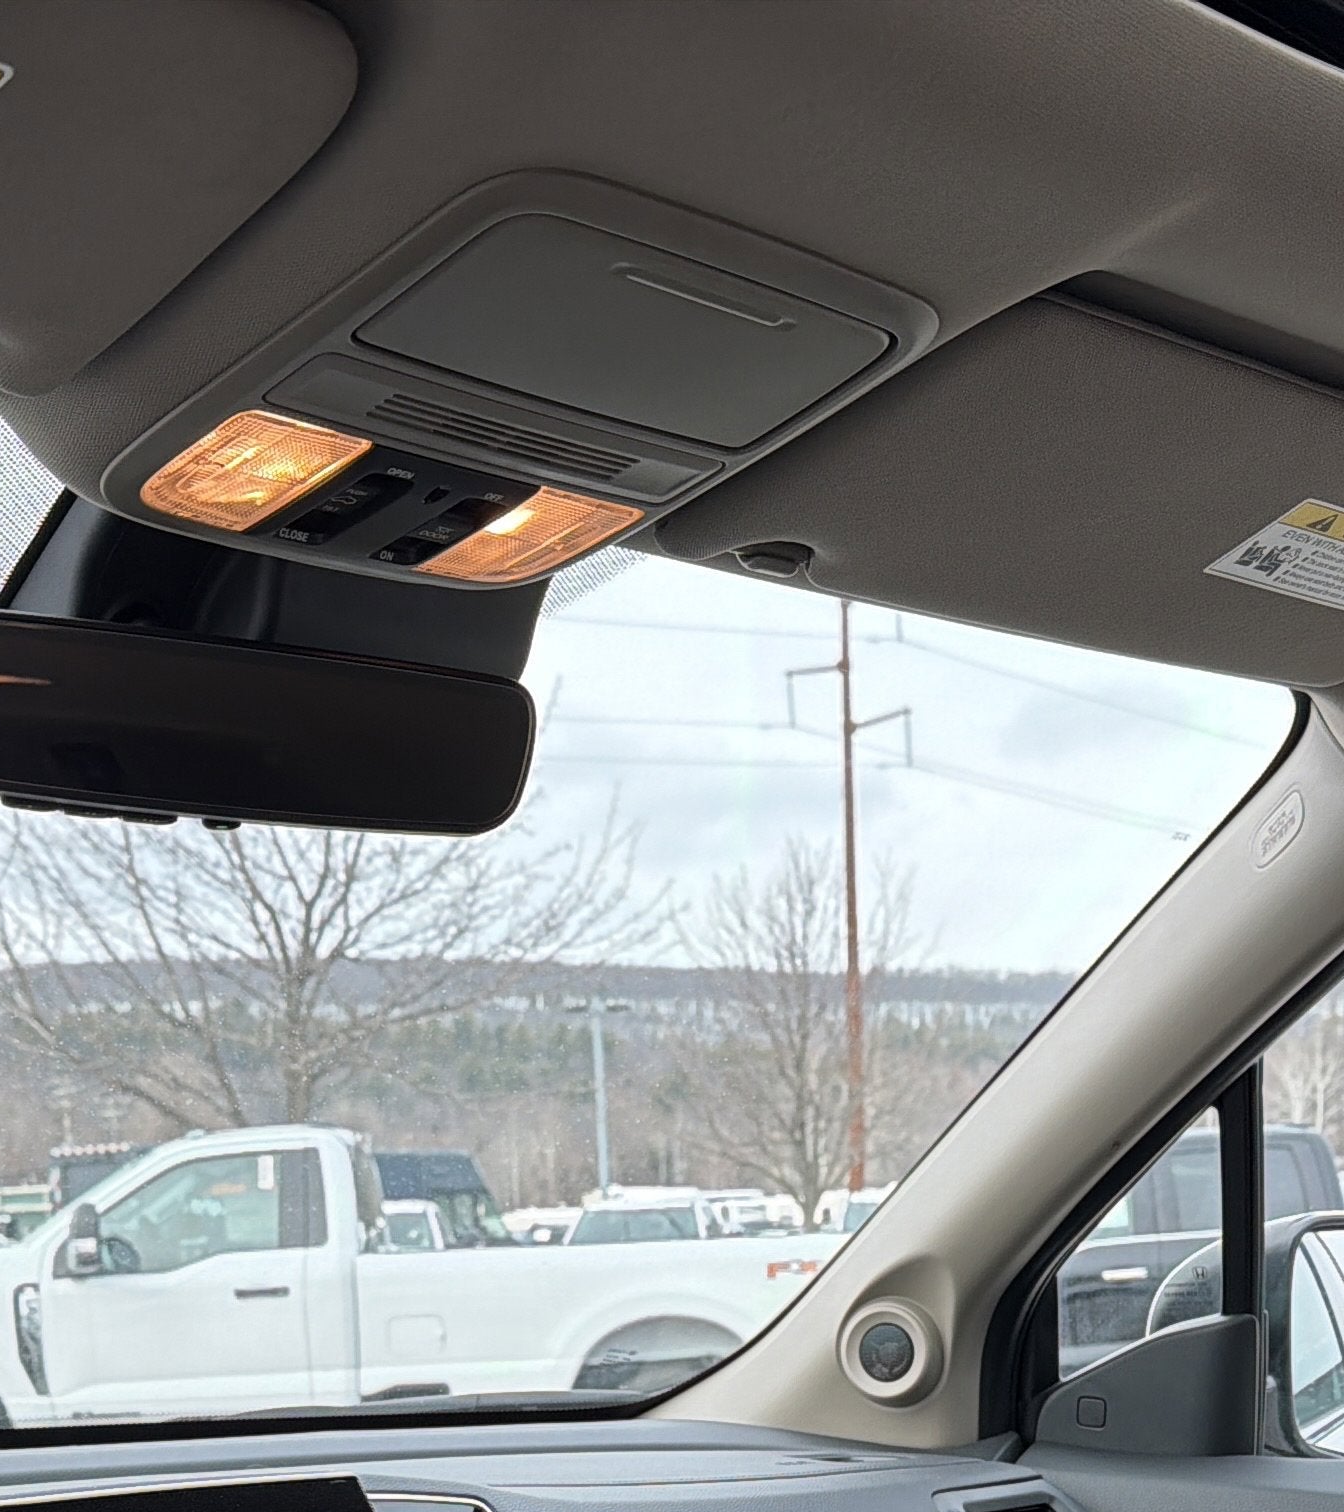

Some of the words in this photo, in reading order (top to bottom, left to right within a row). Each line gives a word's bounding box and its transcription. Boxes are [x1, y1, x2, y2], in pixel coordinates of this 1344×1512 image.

[386, 467, 416, 480] OPEN
[279, 527, 310, 543] CLOSE
[1282, 529, 1311, 544] EVEN
[379, 550, 395, 562] ON
